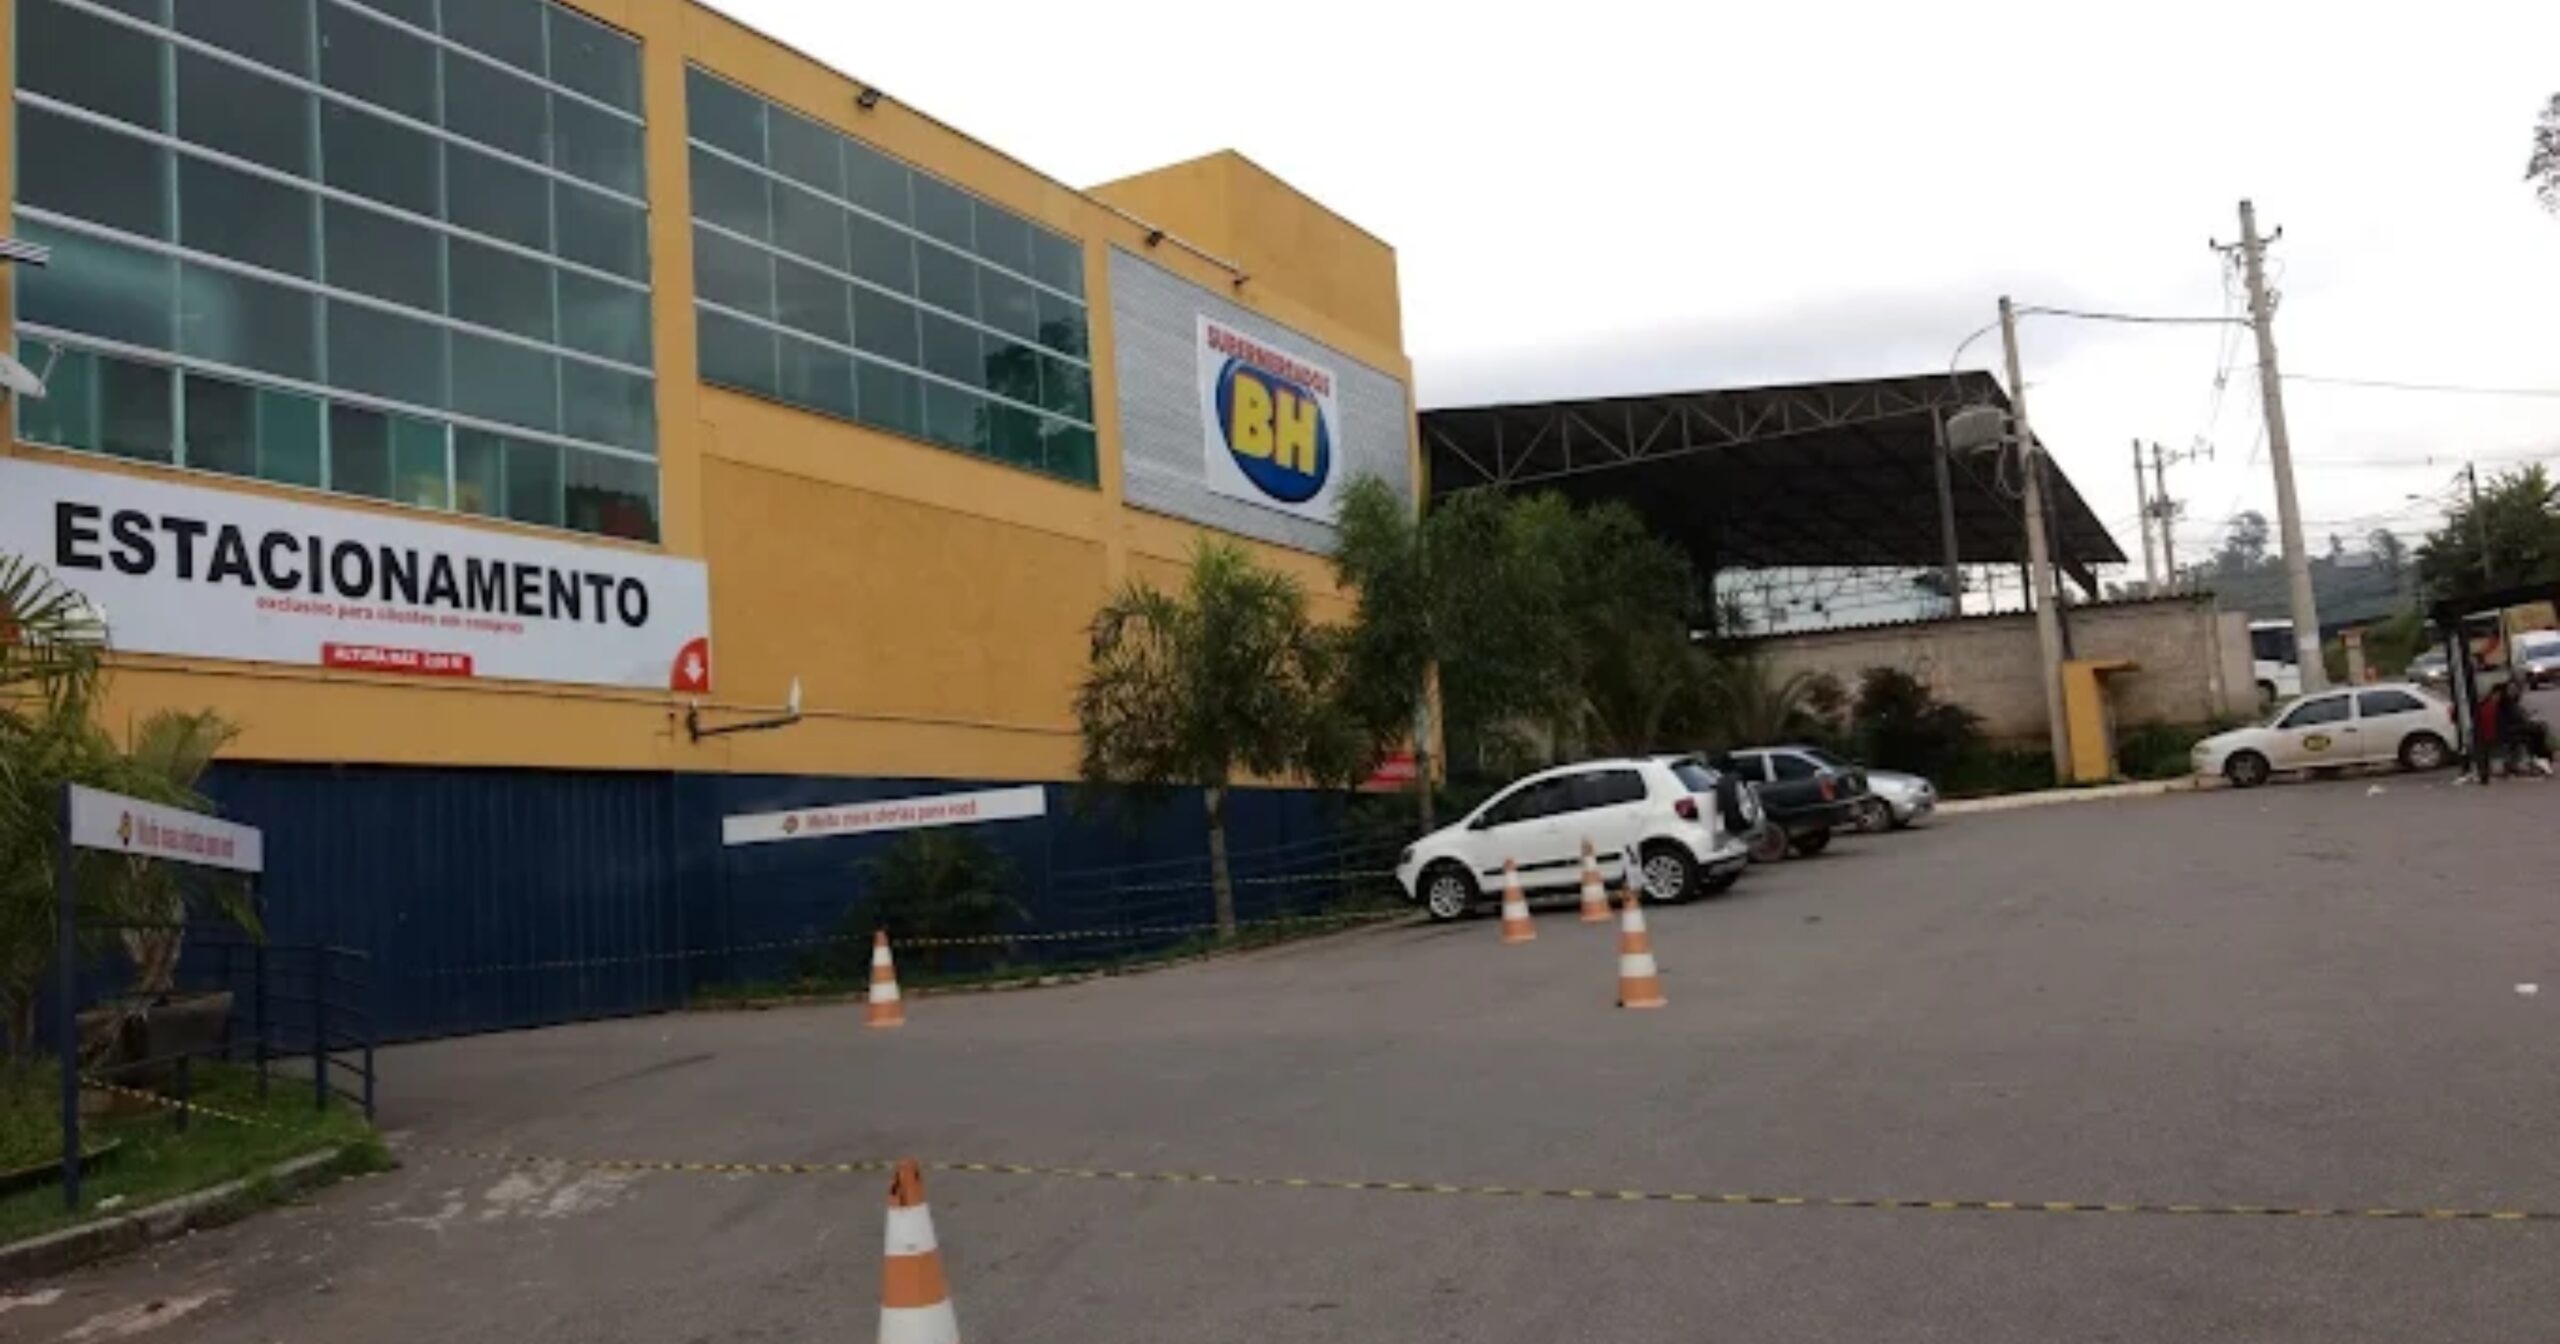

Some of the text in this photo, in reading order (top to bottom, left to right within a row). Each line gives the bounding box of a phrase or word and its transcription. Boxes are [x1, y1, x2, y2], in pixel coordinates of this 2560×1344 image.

[1232, 373, 1316, 476] BH
[55, 500, 650, 627] ESTACIONAMENTO
[338, 605, 374, 621] para
